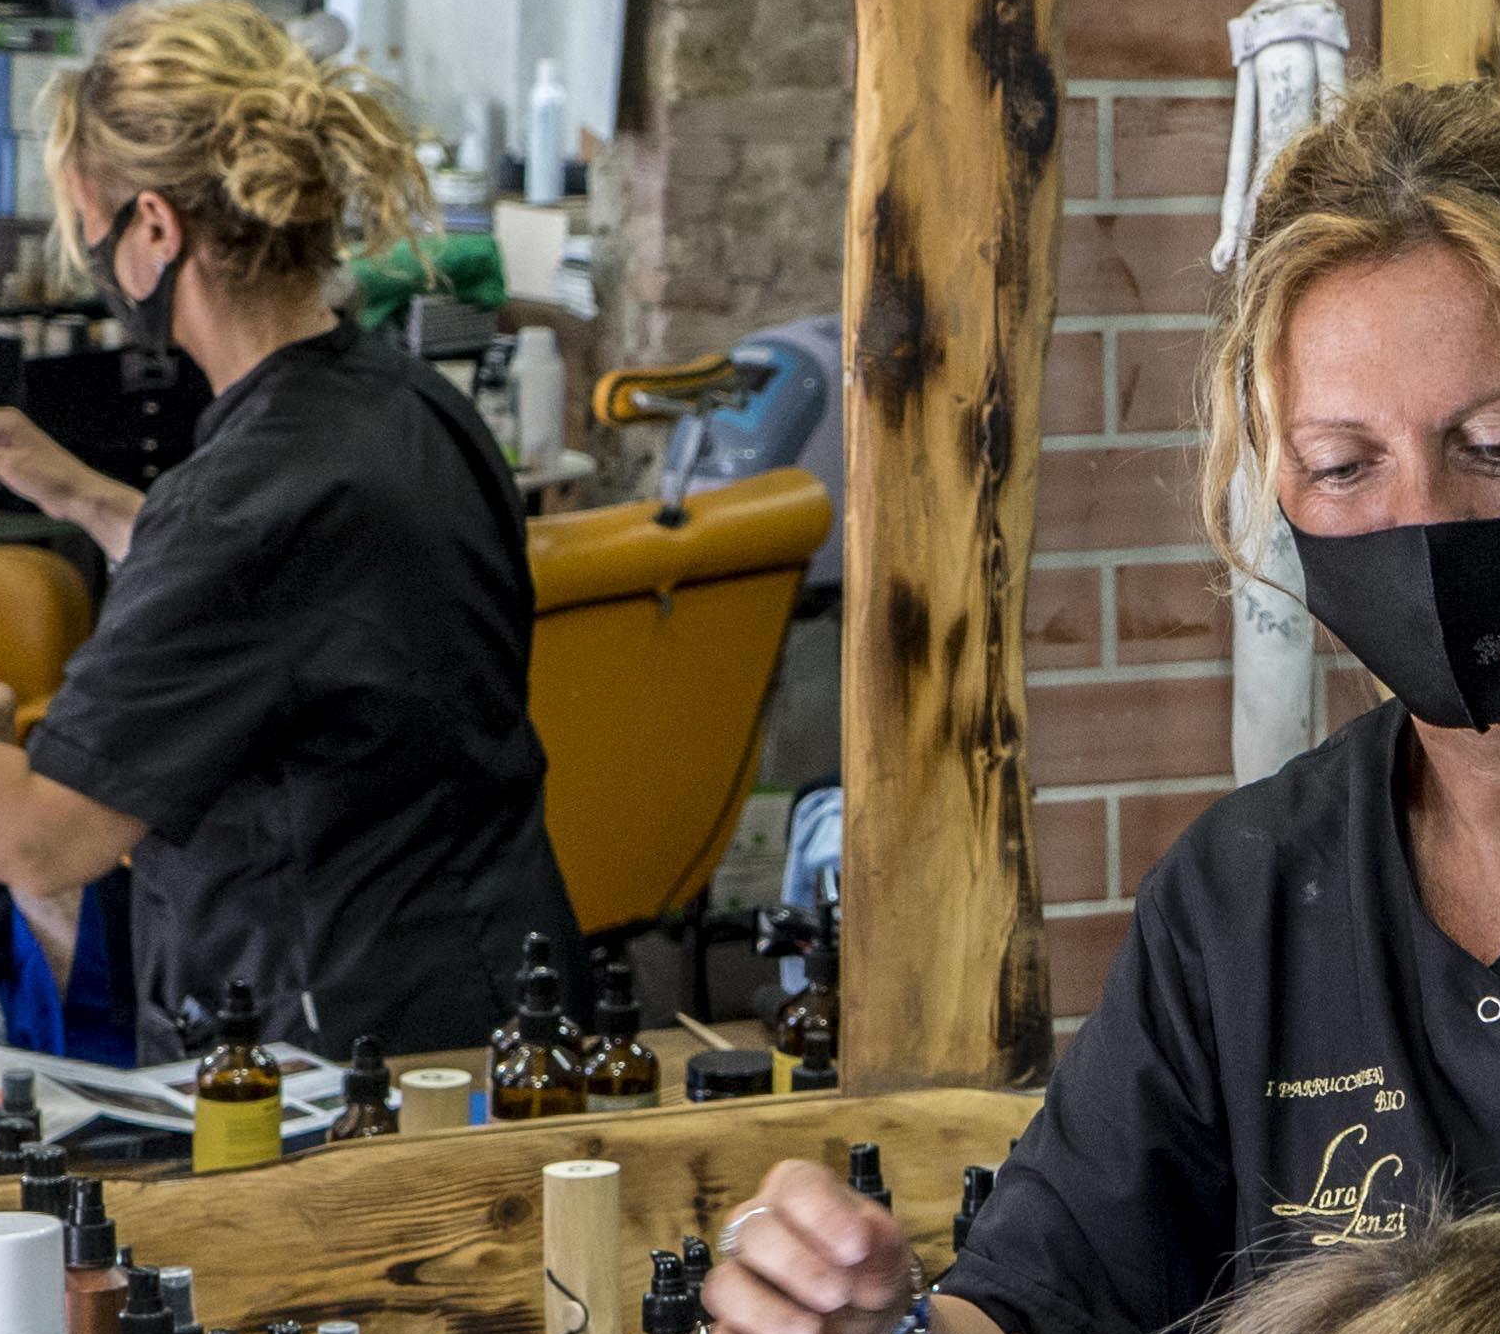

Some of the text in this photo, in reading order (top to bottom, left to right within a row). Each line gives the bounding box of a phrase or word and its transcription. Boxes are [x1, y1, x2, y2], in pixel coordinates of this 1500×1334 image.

[1265, 1080, 1277, 1097] I
[1374, 1089, 1406, 1113] BIO
[1272, 1123, 1368, 1216] Lara
[1311, 1153, 1408, 1247] Lenzi
